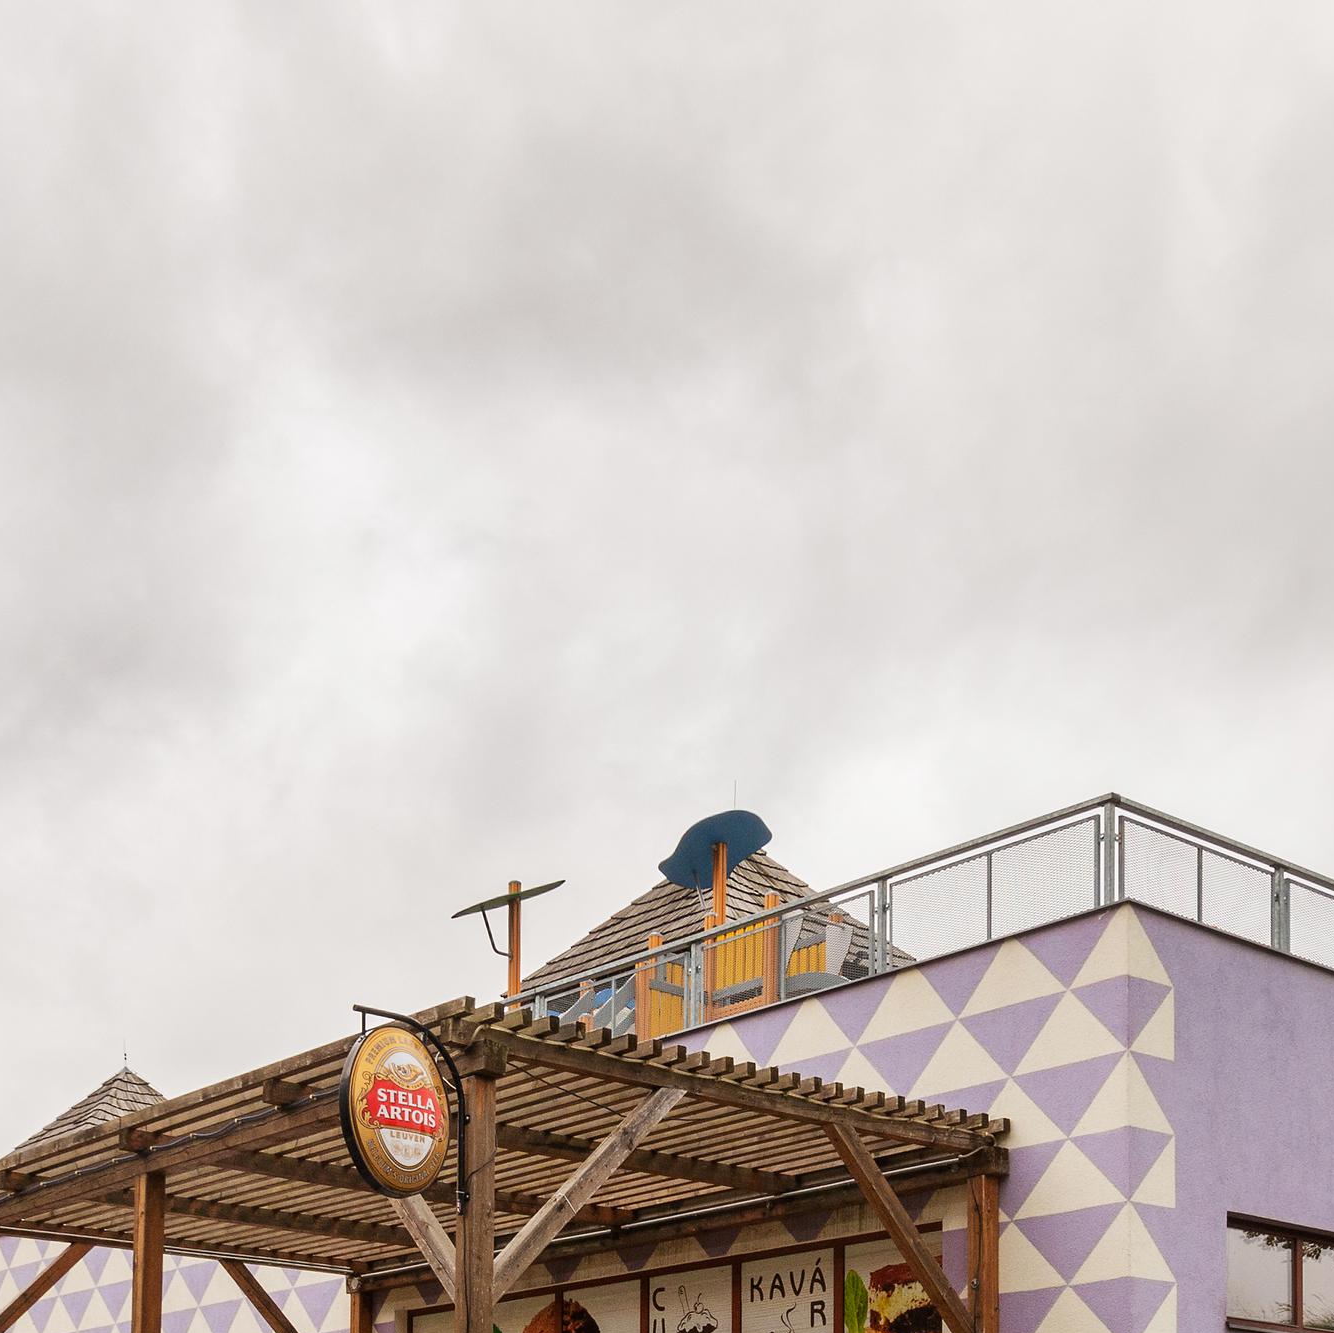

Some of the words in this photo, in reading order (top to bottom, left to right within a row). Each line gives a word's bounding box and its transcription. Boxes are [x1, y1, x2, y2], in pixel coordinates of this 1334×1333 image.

[377, 1087, 436, 1112] STELLA
[376, 1105, 436, 1128] ARTOIS
[389, 1130, 426, 1144] LEUVEN
